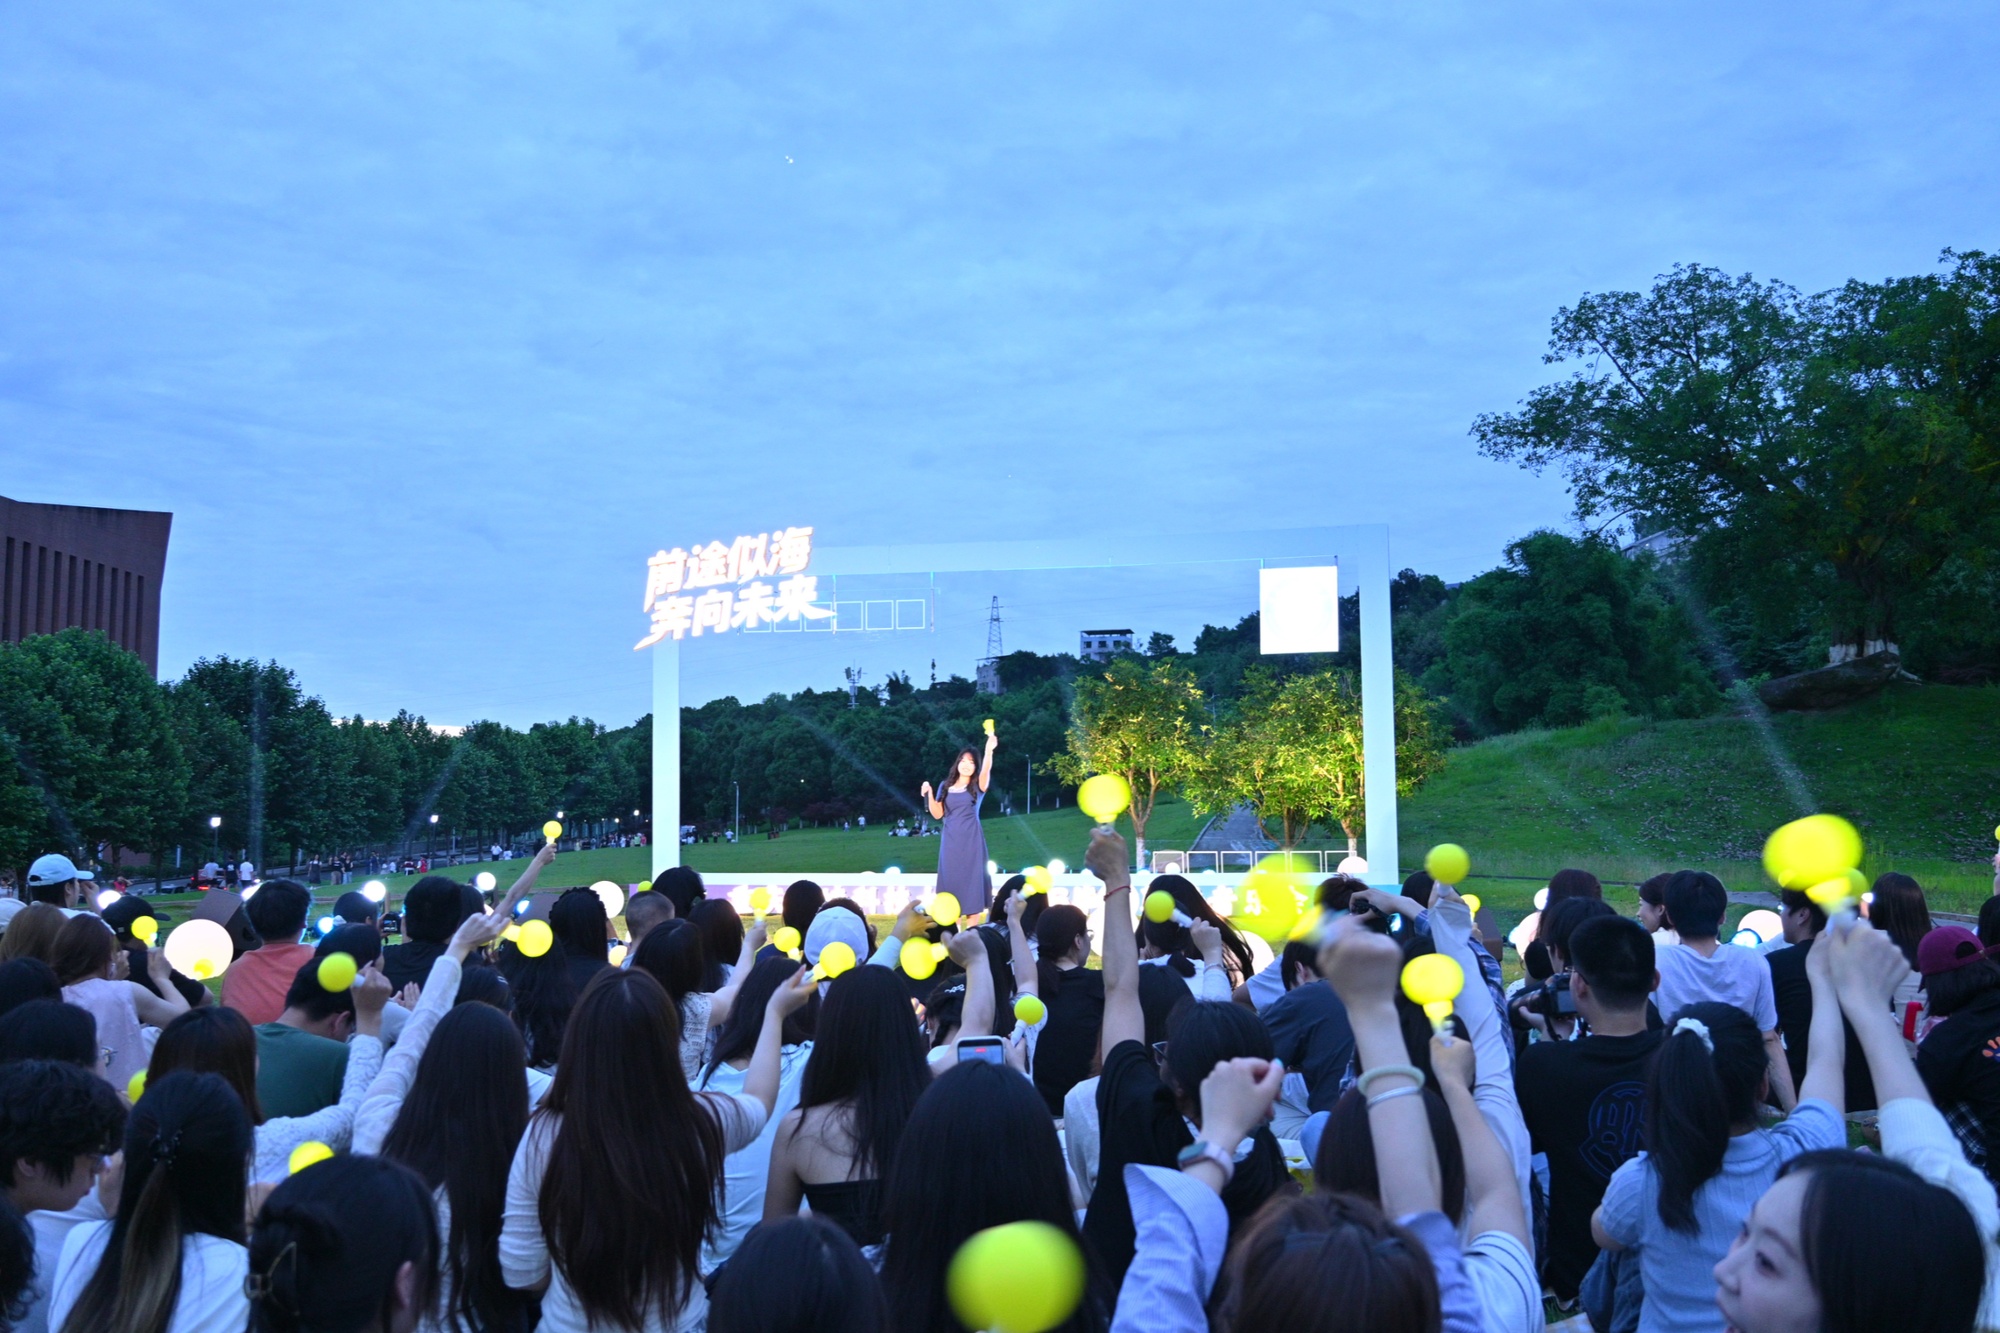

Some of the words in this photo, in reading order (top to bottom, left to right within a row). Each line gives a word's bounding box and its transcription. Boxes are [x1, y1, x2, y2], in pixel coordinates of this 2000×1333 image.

[643, 526, 814, 613] 前途似海
[633, 574, 837, 651] 奔向未来
